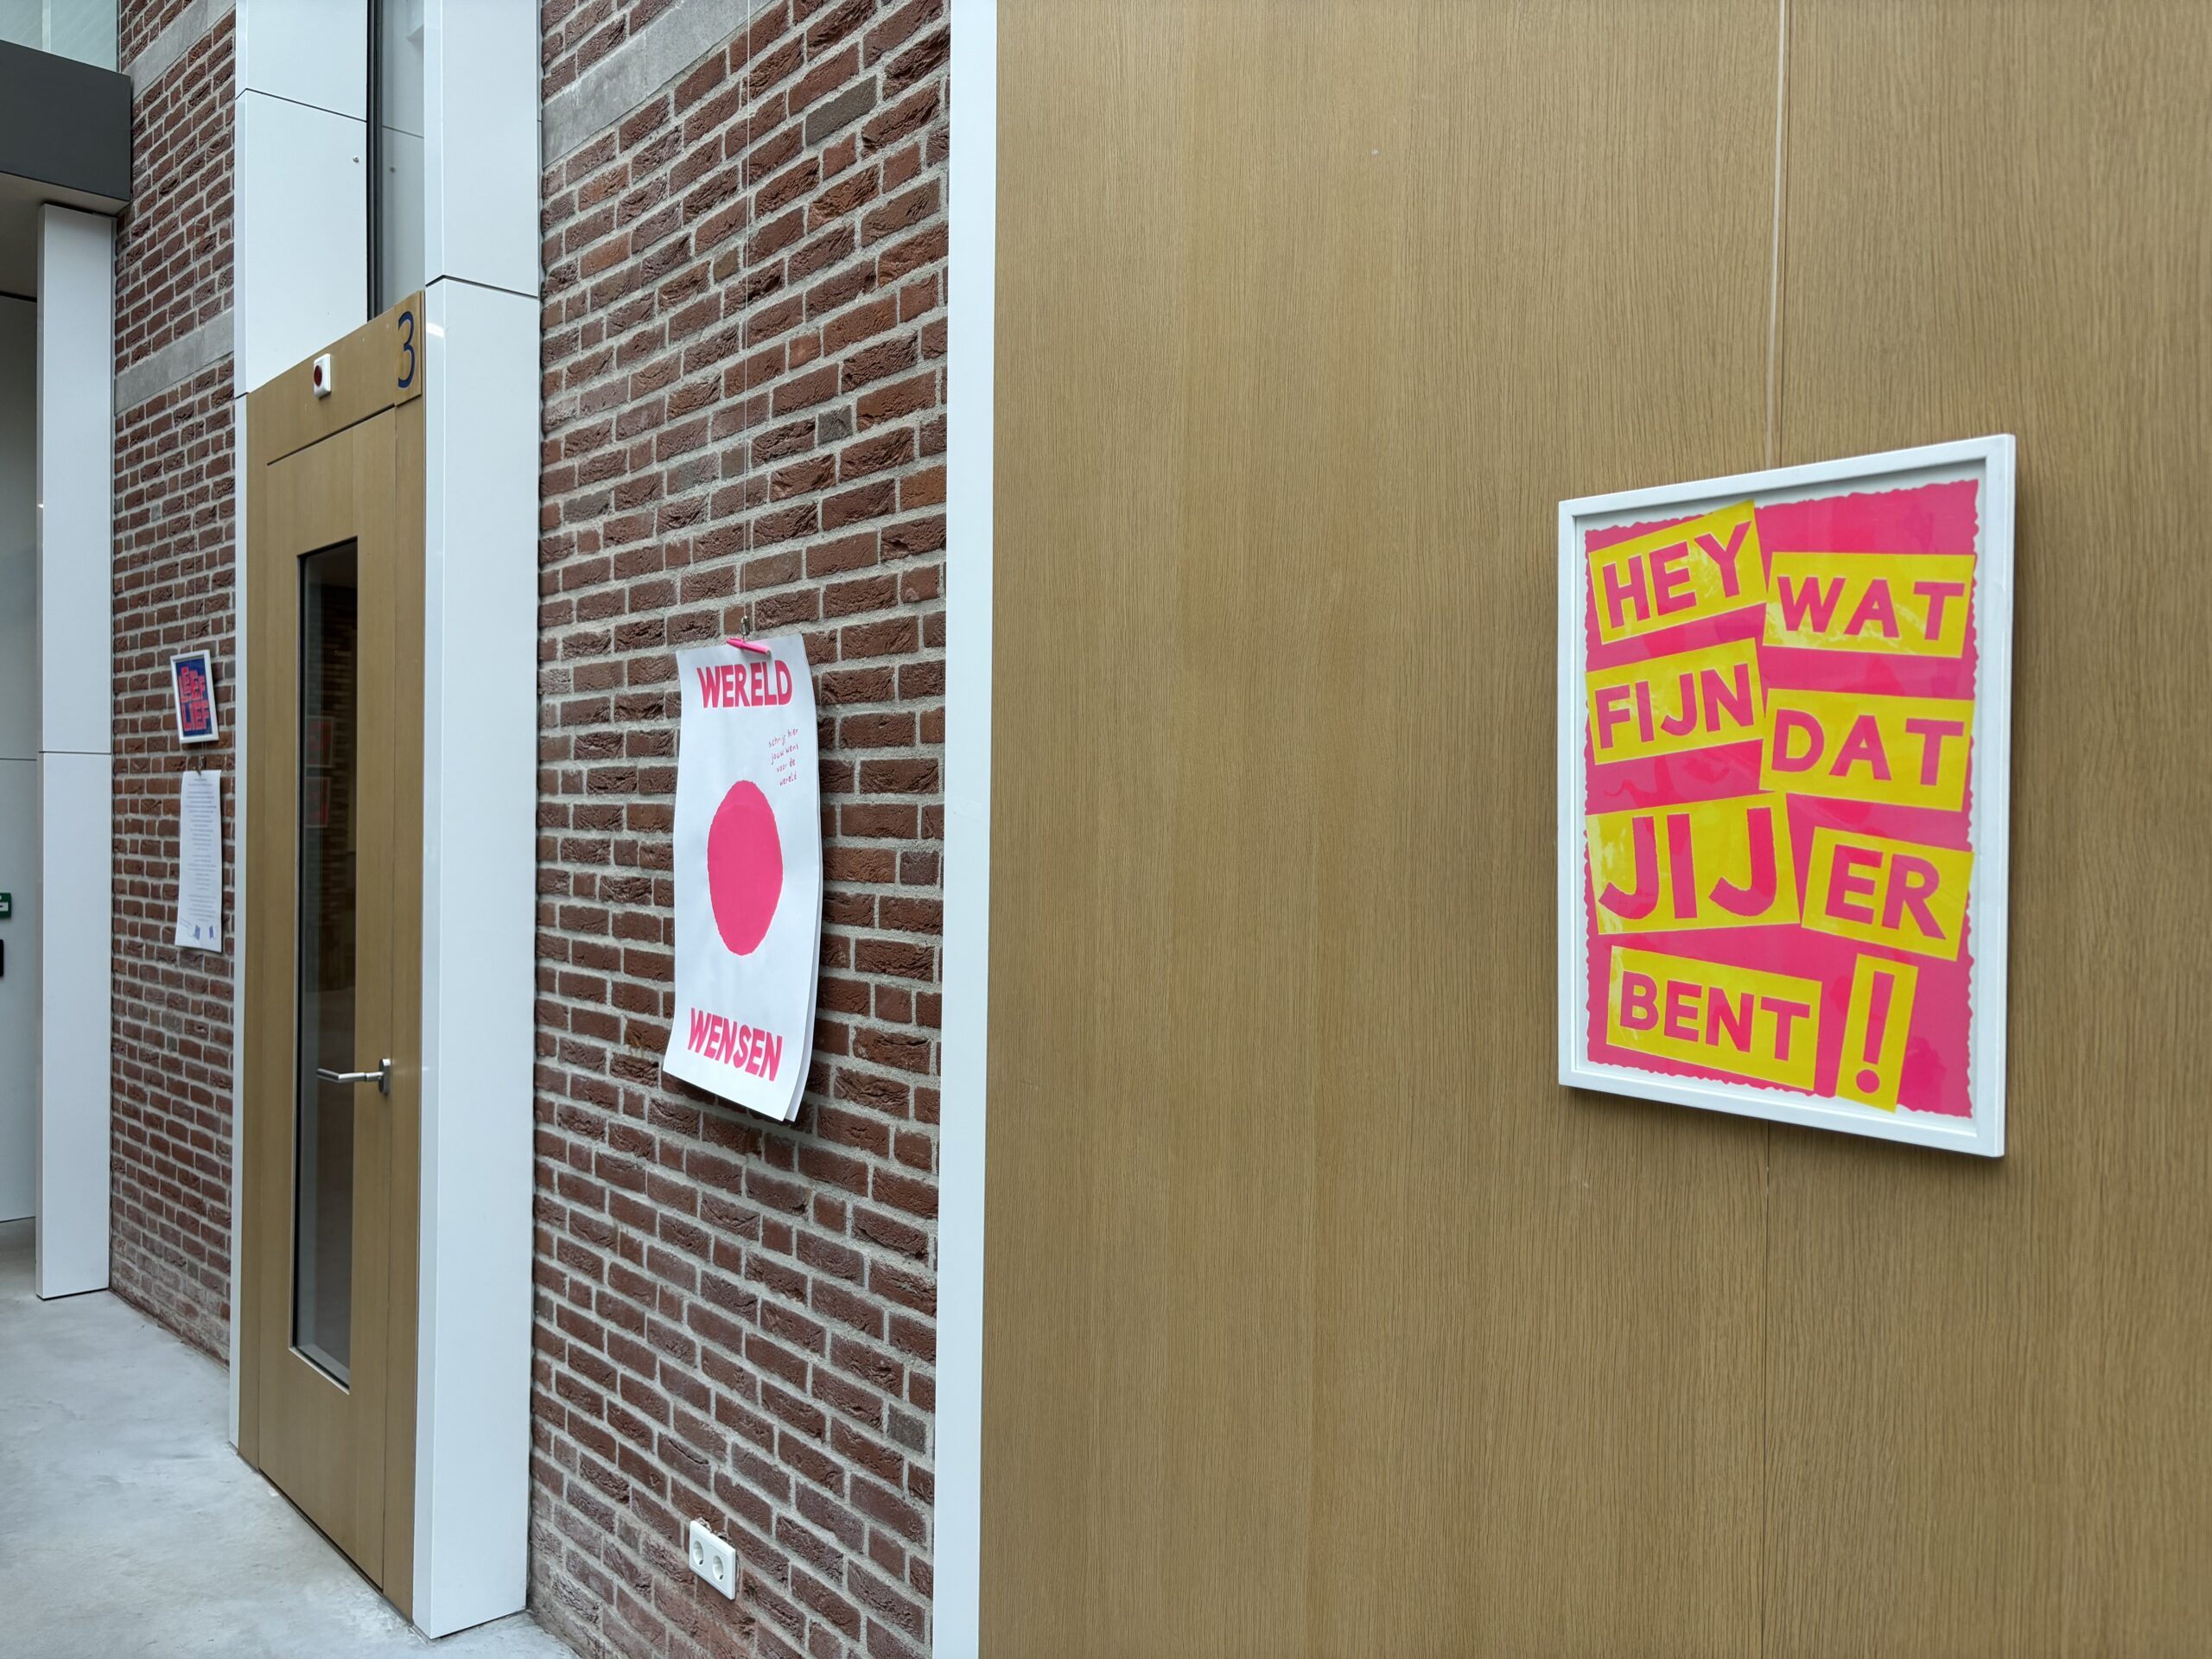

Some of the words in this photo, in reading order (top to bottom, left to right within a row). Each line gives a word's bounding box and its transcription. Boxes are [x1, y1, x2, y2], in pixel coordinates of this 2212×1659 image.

[397, 310, 415, 389] 3
[1603, 520, 1752, 629] HEY
[1777, 575, 1966, 641] WAT
[178, 666, 207, 703] LEEF
[696, 660, 792, 709] WERELD
[181, 700, 209, 732] LIEF
[787, 728, 798, 739] hier
[1595, 663, 1755, 750] FIJN
[1771, 709, 1965, 787] DAT
[771, 750, 785, 766] jouw
[785, 743, 799, 753] wens
[776, 763, 787, 773] voor
[789, 757, 796, 767] de
[779, 771, 798, 786] wereld
[1598, 807, 1777, 920] JIJ
[1825, 844, 1947, 940] ER
[1620, 970, 1811, 1062] BENT
[688, 1007, 783, 1082] WENSEN
